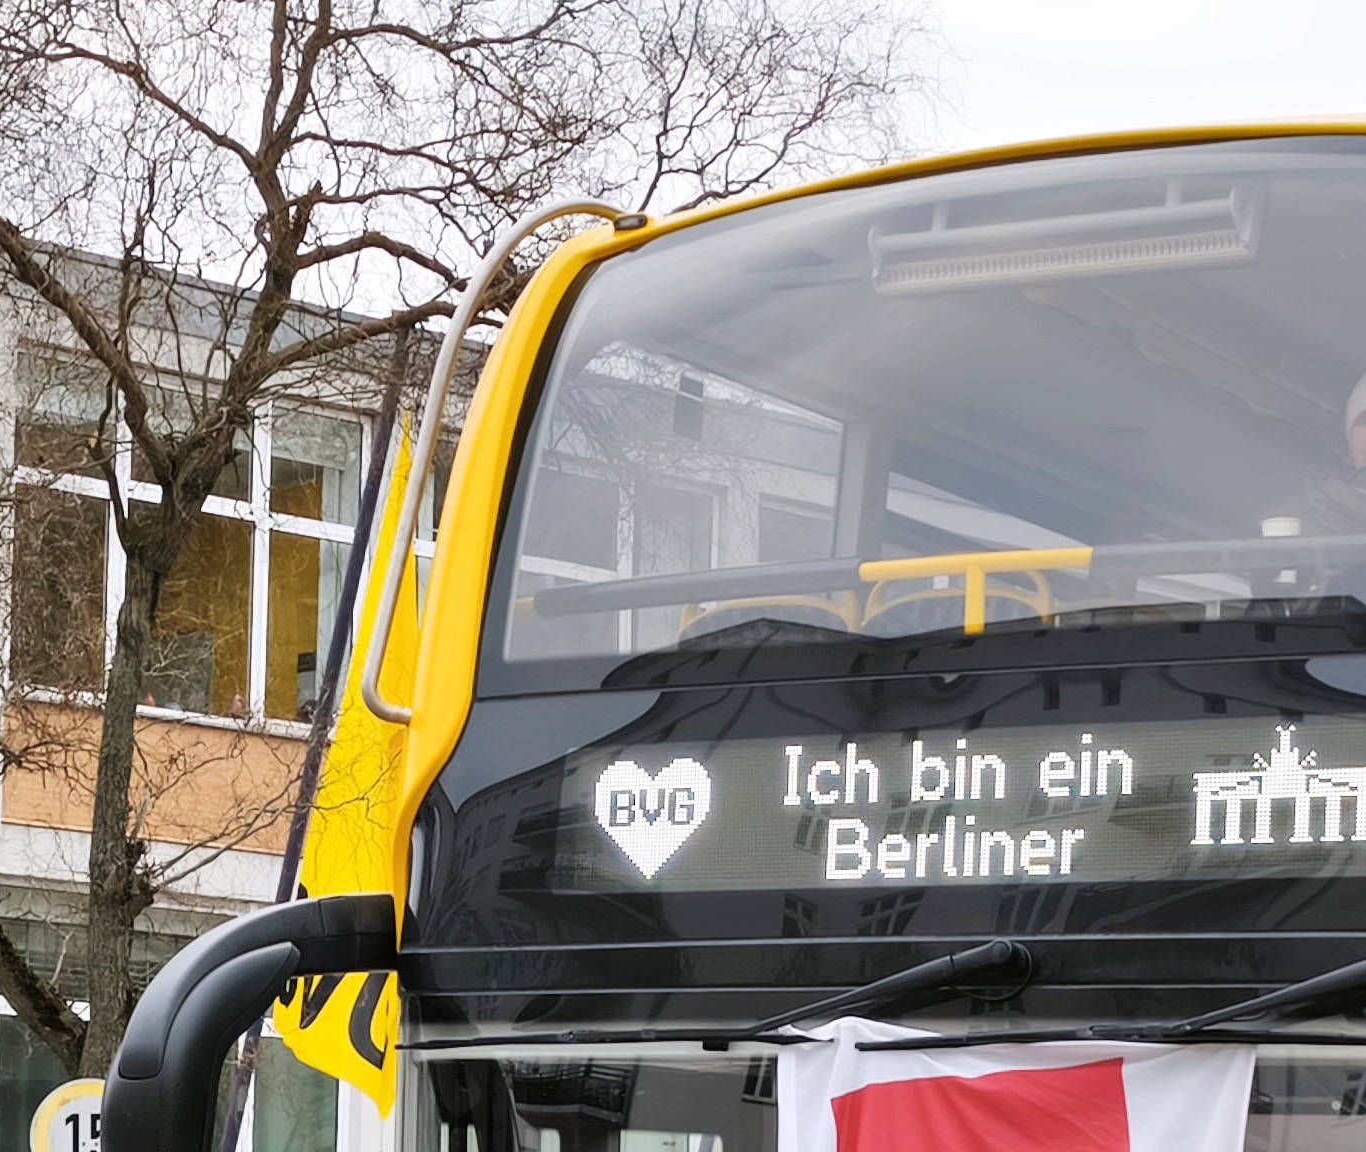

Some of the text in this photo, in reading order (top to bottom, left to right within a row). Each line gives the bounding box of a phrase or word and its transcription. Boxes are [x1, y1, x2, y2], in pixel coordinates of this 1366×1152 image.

[783, 733, 1133, 807] Ich bin ein
[610, 787, 695, 827] BVG
[825, 817, 1085, 882] Berliner
